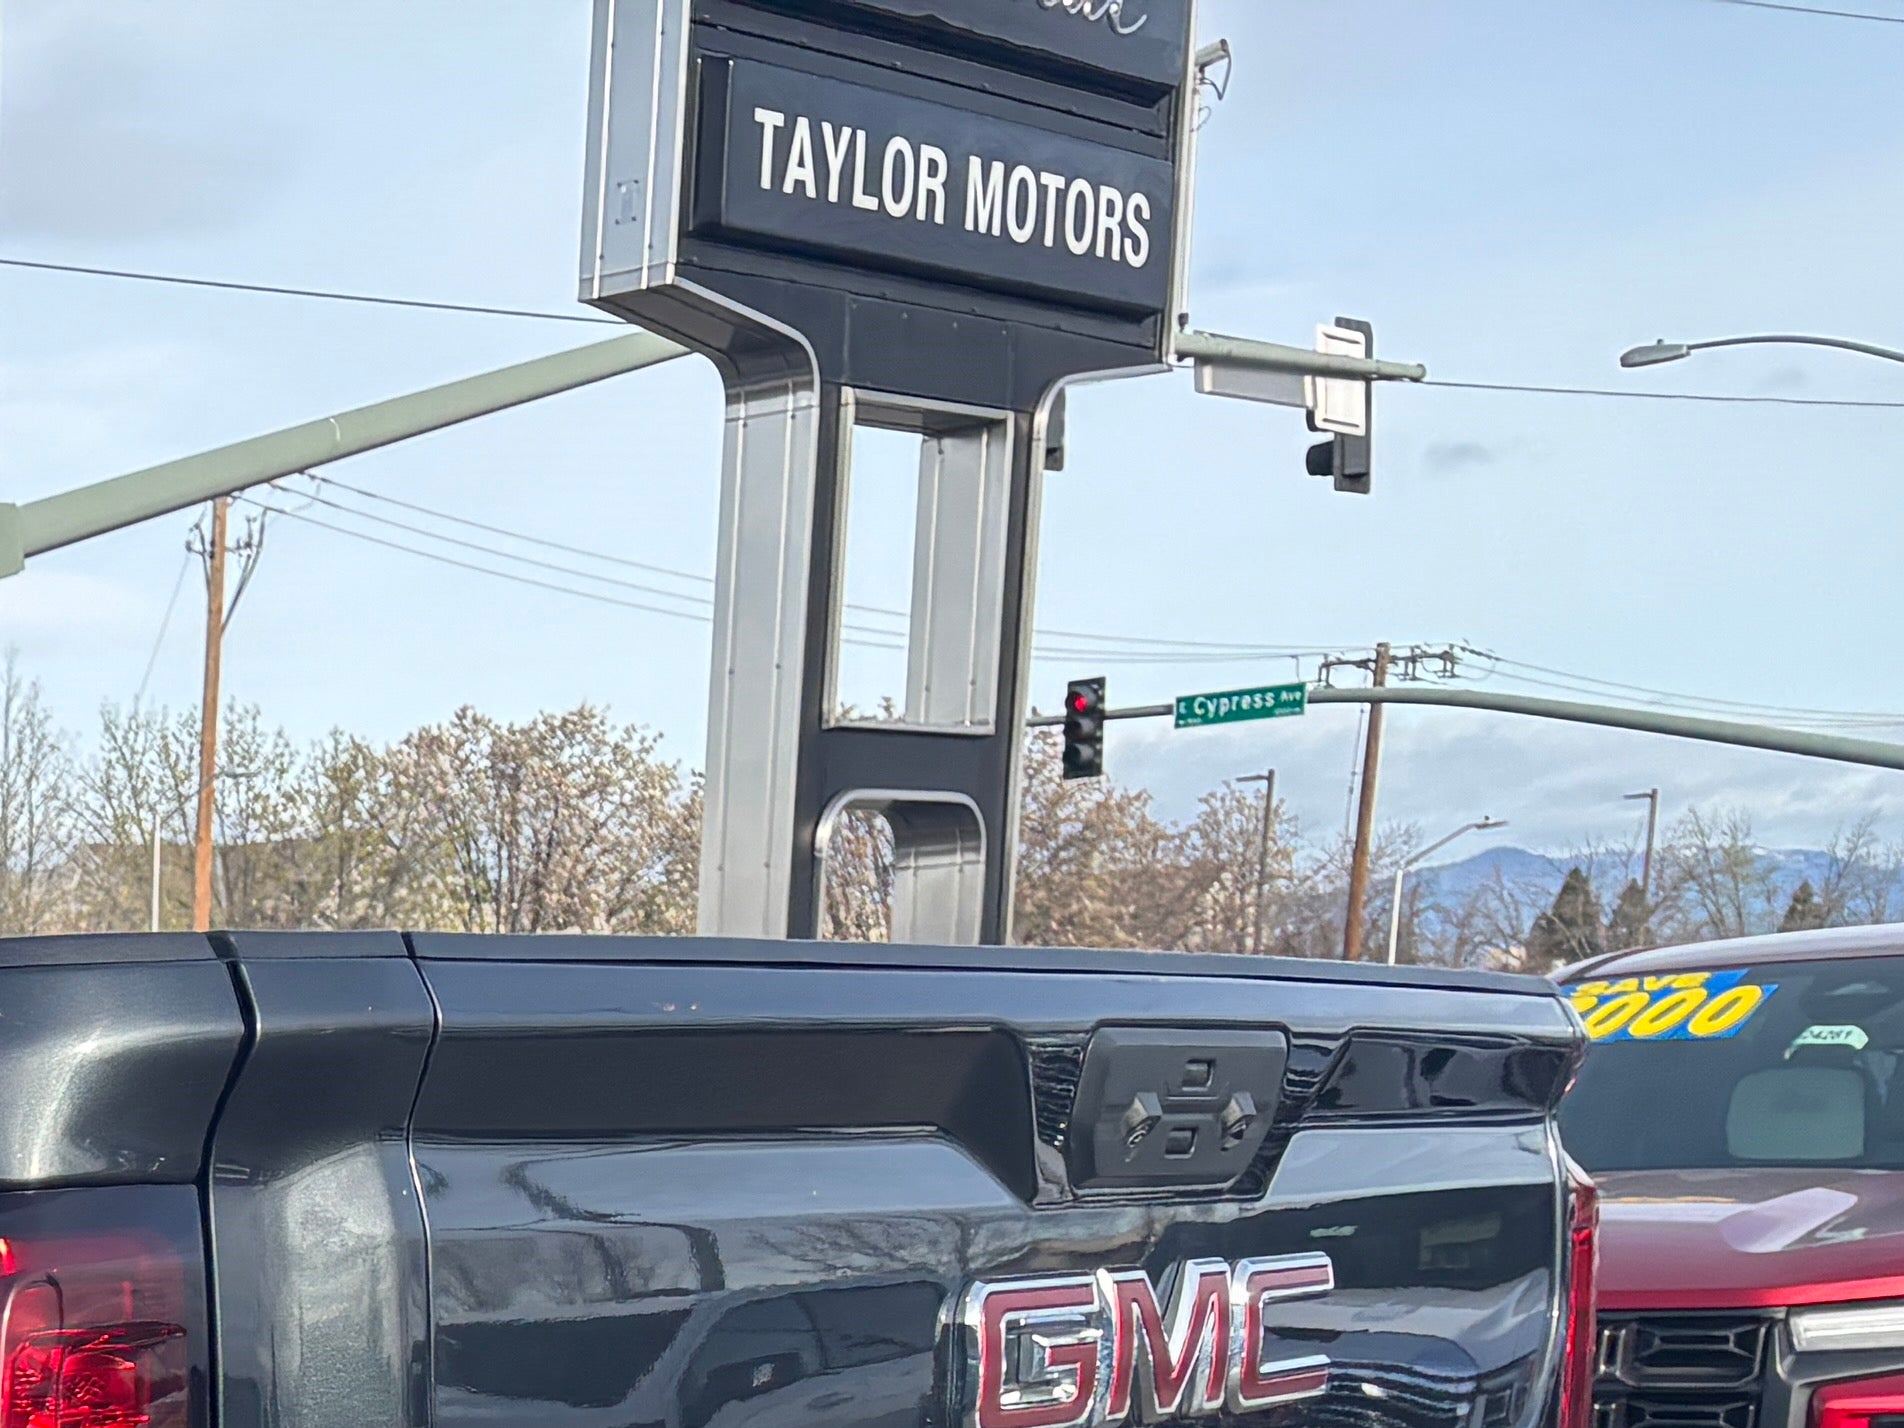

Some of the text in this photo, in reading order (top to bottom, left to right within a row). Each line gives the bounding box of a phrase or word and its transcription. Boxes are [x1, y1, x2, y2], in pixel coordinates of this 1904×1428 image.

[754, 107, 1151, 268] TAYLOR MOTORS
[1193, 691, 1275, 718] Cypress
